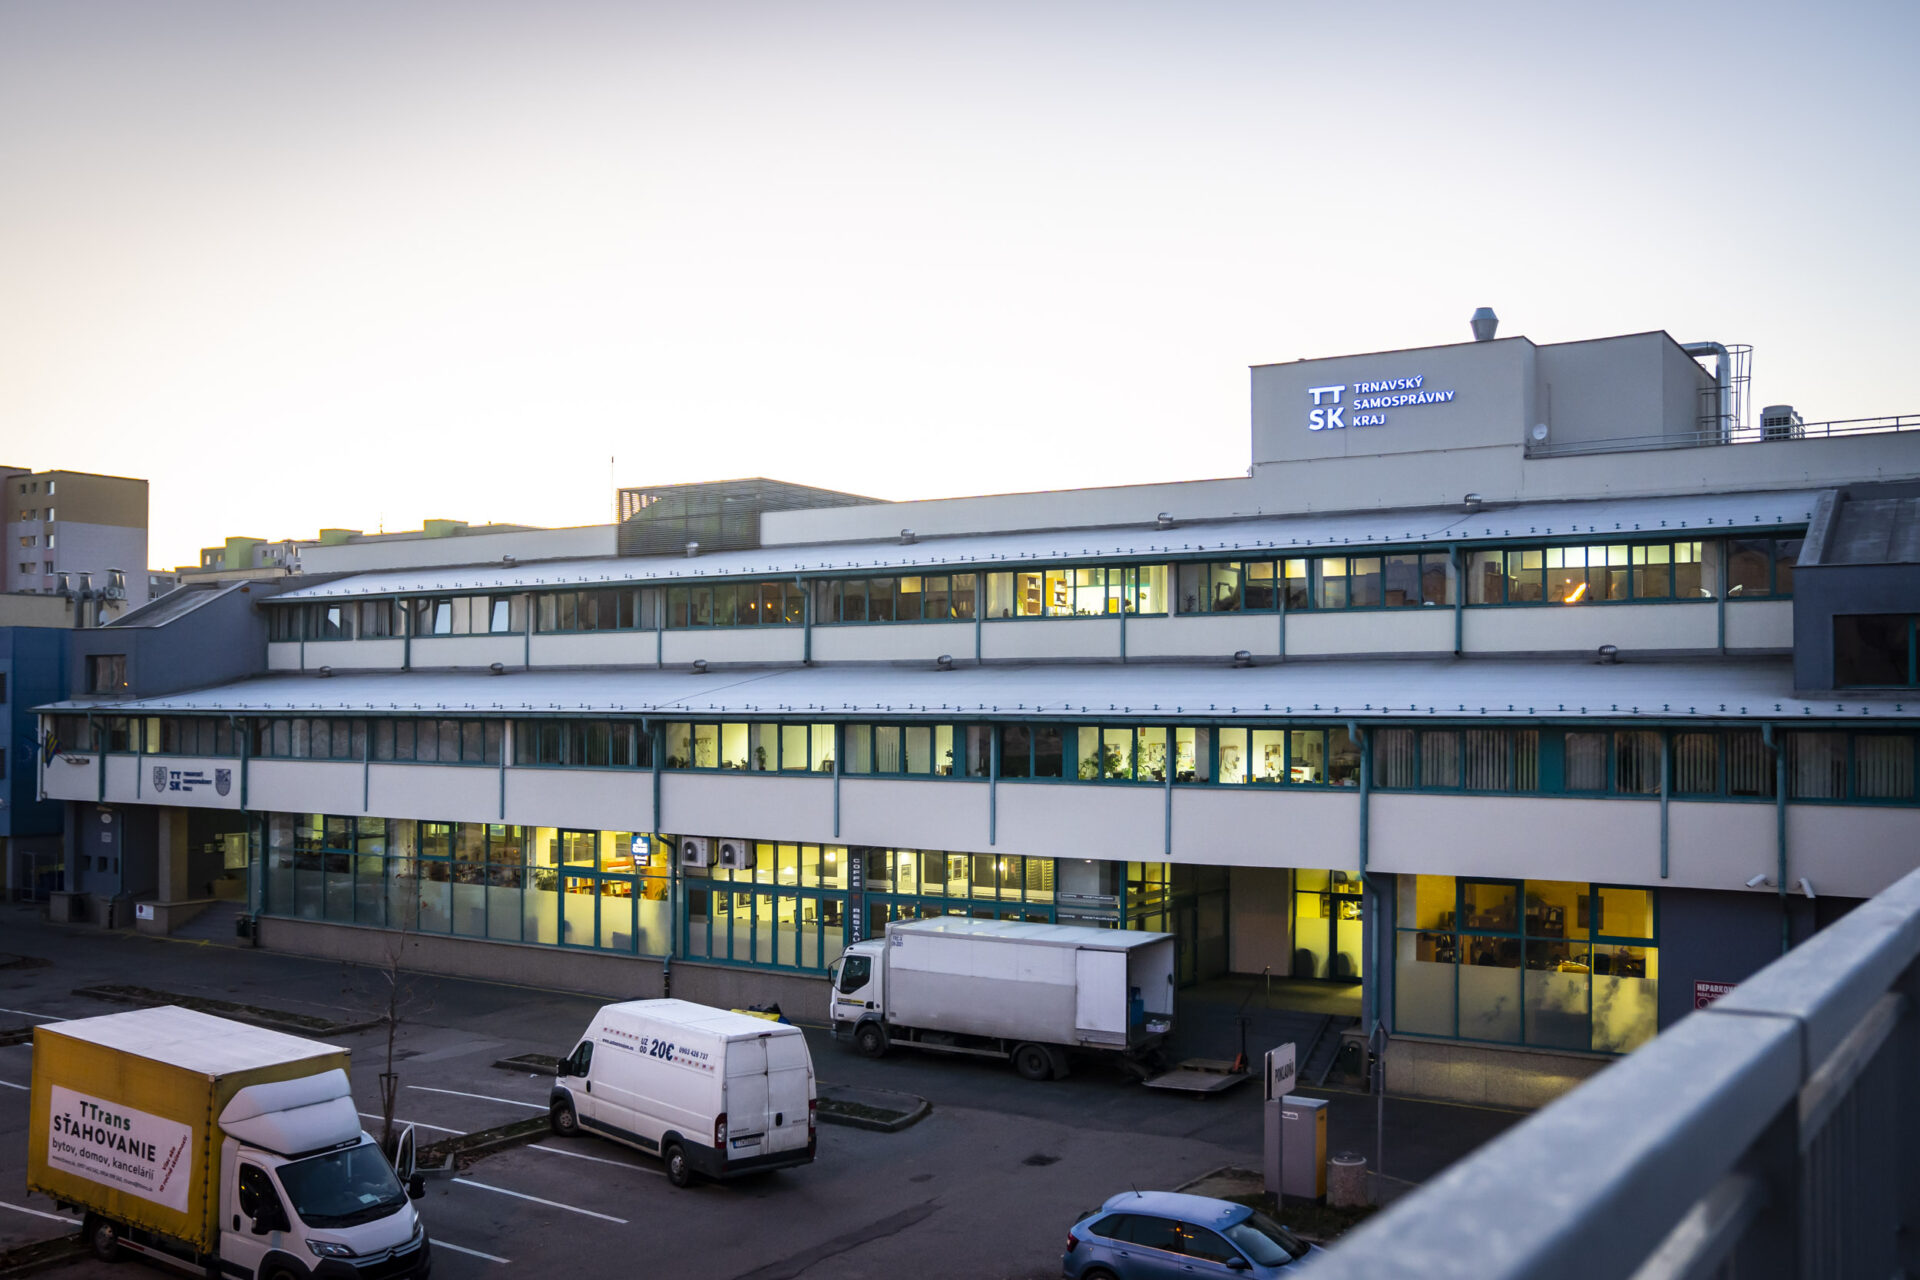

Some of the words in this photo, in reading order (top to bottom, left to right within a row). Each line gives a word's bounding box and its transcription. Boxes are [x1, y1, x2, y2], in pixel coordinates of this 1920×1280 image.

[1308, 385, 1346, 405] TT
[1353, 375, 1423, 394] TRNAVSKÝ
[1353, 390, 1455, 410] SAMOSPRÁVNY
[1308, 406, 1345, 430] SK
[1352, 414, 1386, 427] KRAJ
[169, 780, 181, 791] SK
[649, 1038, 675, 1061] 20€
[80, 1100, 131, 1131] TTrans
[53, 1112, 156, 1163] SŤAHOVANIE
[52, 1137, 78, 1157] bytov,
[79, 1147, 111, 1167] domov,
